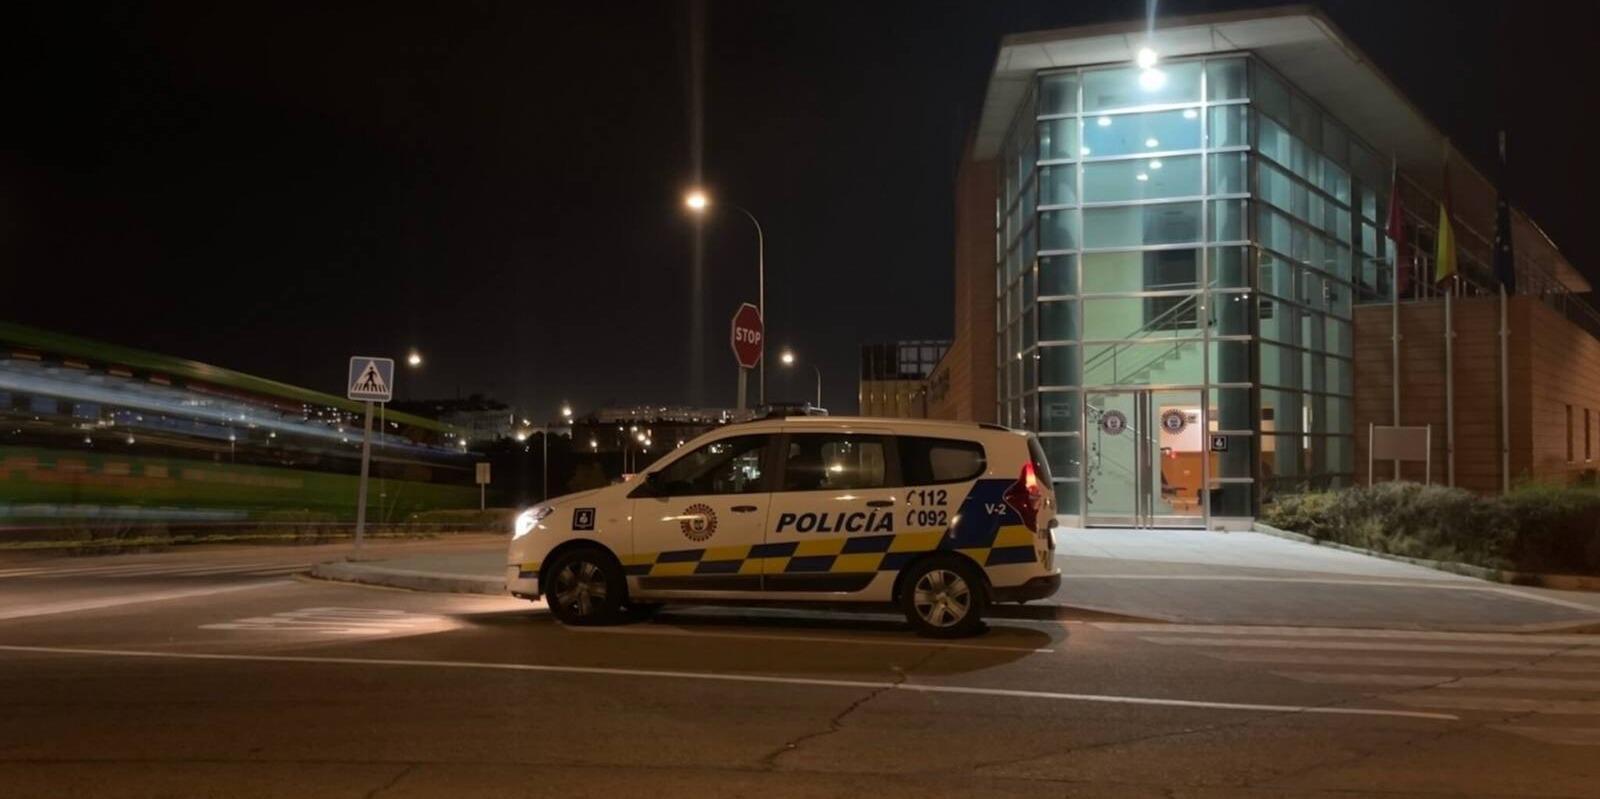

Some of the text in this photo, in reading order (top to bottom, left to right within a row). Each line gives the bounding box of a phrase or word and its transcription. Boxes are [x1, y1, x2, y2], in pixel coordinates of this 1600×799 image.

[736, 327, 761, 344] STOP
[919, 490, 947, 506] 112
[985, 503, 1007, 515] V-2
[918, 510, 947, 526] 092
